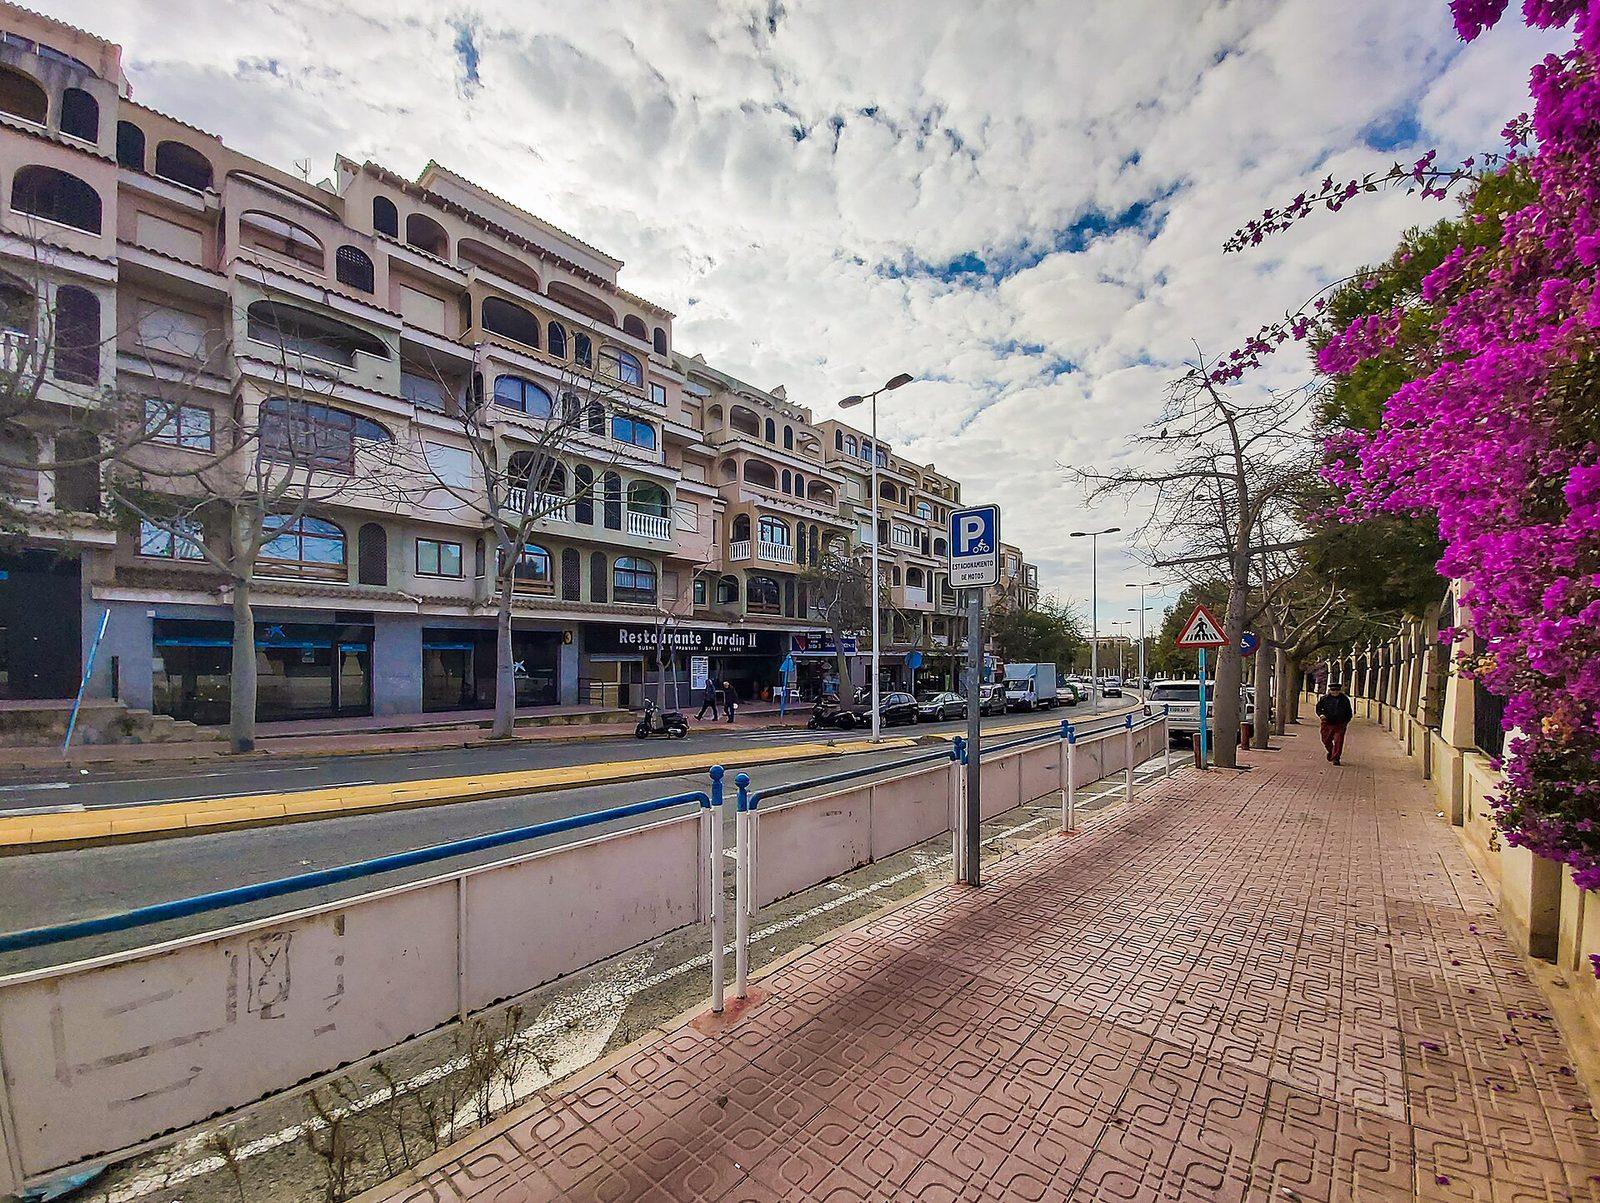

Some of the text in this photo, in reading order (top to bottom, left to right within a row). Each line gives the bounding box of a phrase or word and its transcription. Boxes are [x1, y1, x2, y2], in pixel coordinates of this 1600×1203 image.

[960, 515, 985, 552] P
[952, 560, 994, 570] ESTACIONAMIENTO
[968, 573, 984, 581] MOTOS
[619, 628, 702, 645] Restaurante
[712, 632, 745, 646] Jardin
